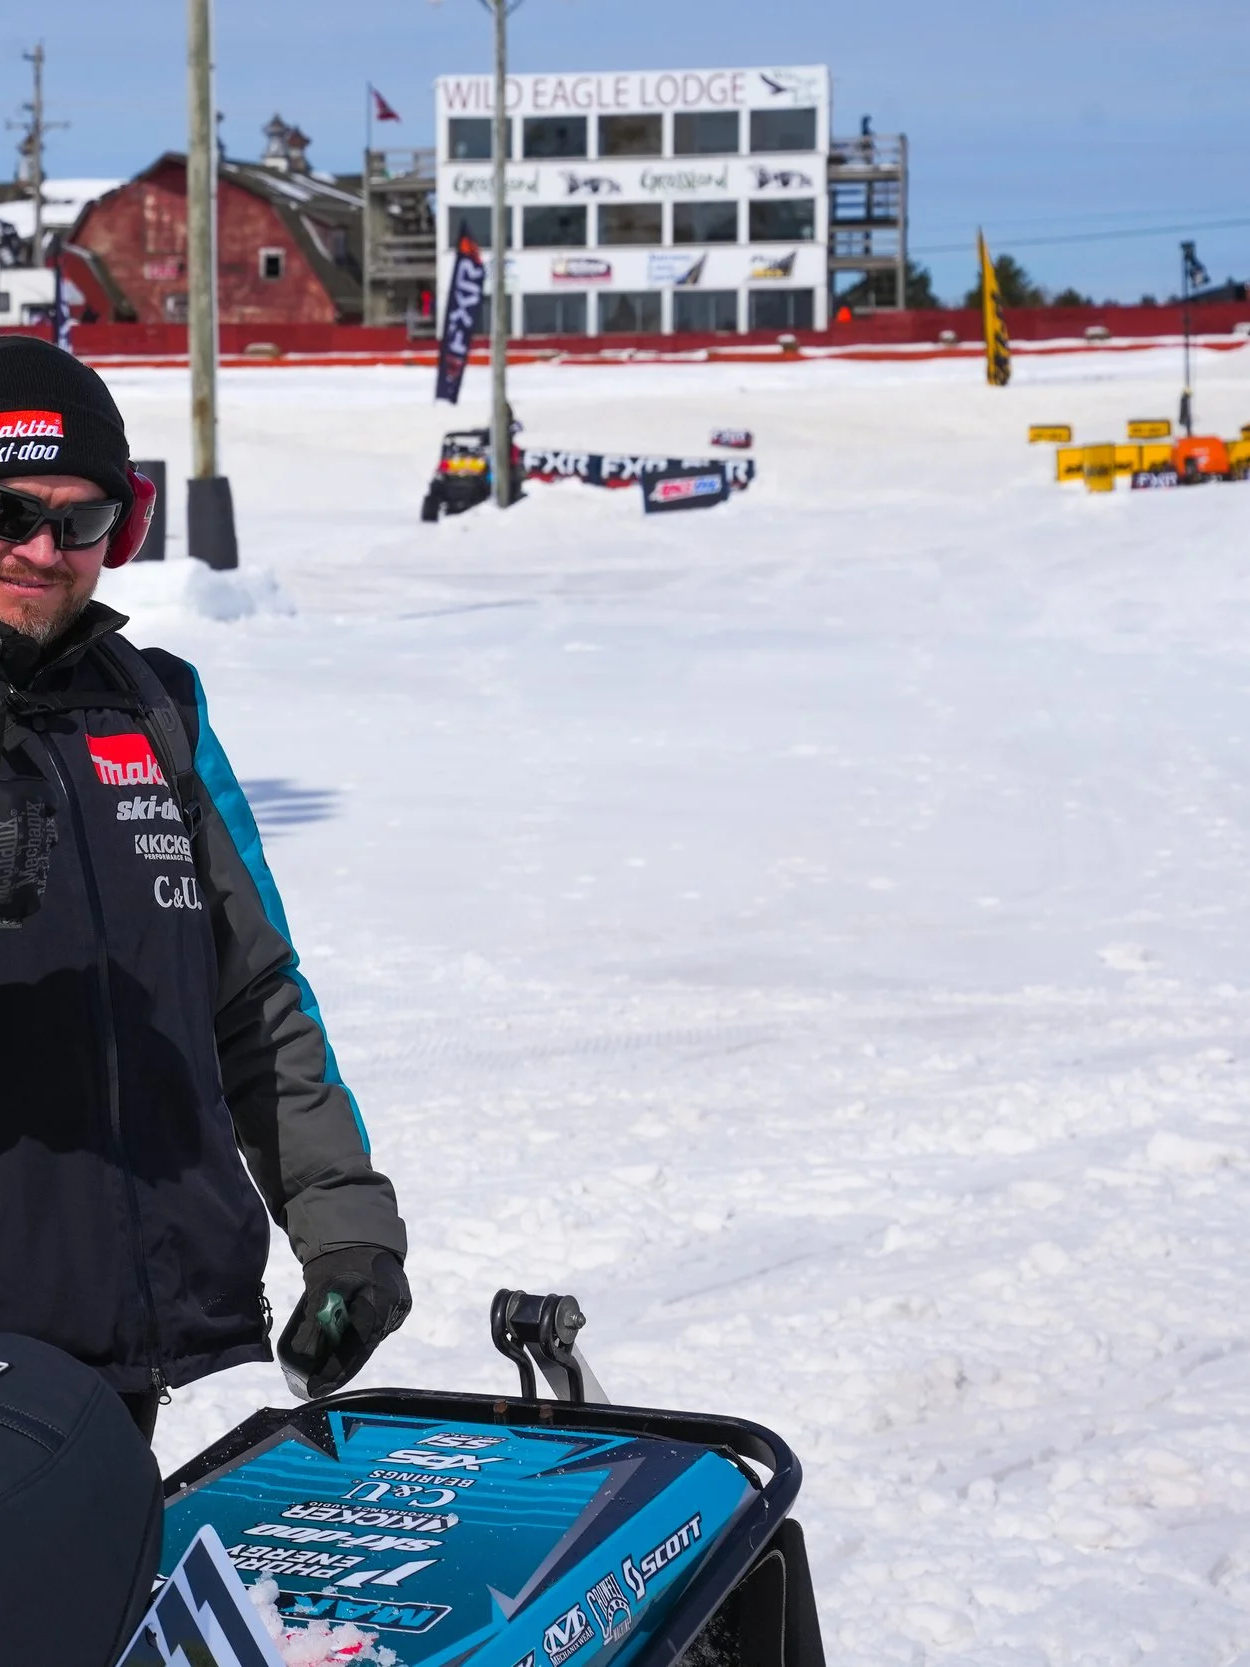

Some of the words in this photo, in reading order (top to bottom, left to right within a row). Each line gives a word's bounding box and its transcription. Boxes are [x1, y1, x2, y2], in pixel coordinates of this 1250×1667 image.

[532, 74, 630, 110] EAGLE
[639, 71, 747, 106] LODGE
[448, 258, 485, 356] FXR
[523, 451, 590, 477] FXR
[368, 1469, 476, 1488] BEARINGS
[281, 1505, 420, 1531] KICKER
[309, 1501, 352, 1511] AUDIO
[353, 1504, 452, 1520] PERFORMANCE
[243, 1524, 443, 1552] ski-doo
[641, 1515, 702, 1580] SCOTT
[226, 1544, 366, 1569] ENERGY
[549, 1643, 580, 1667] MECHANIX
[577, 1624, 596, 1648] WEAR
